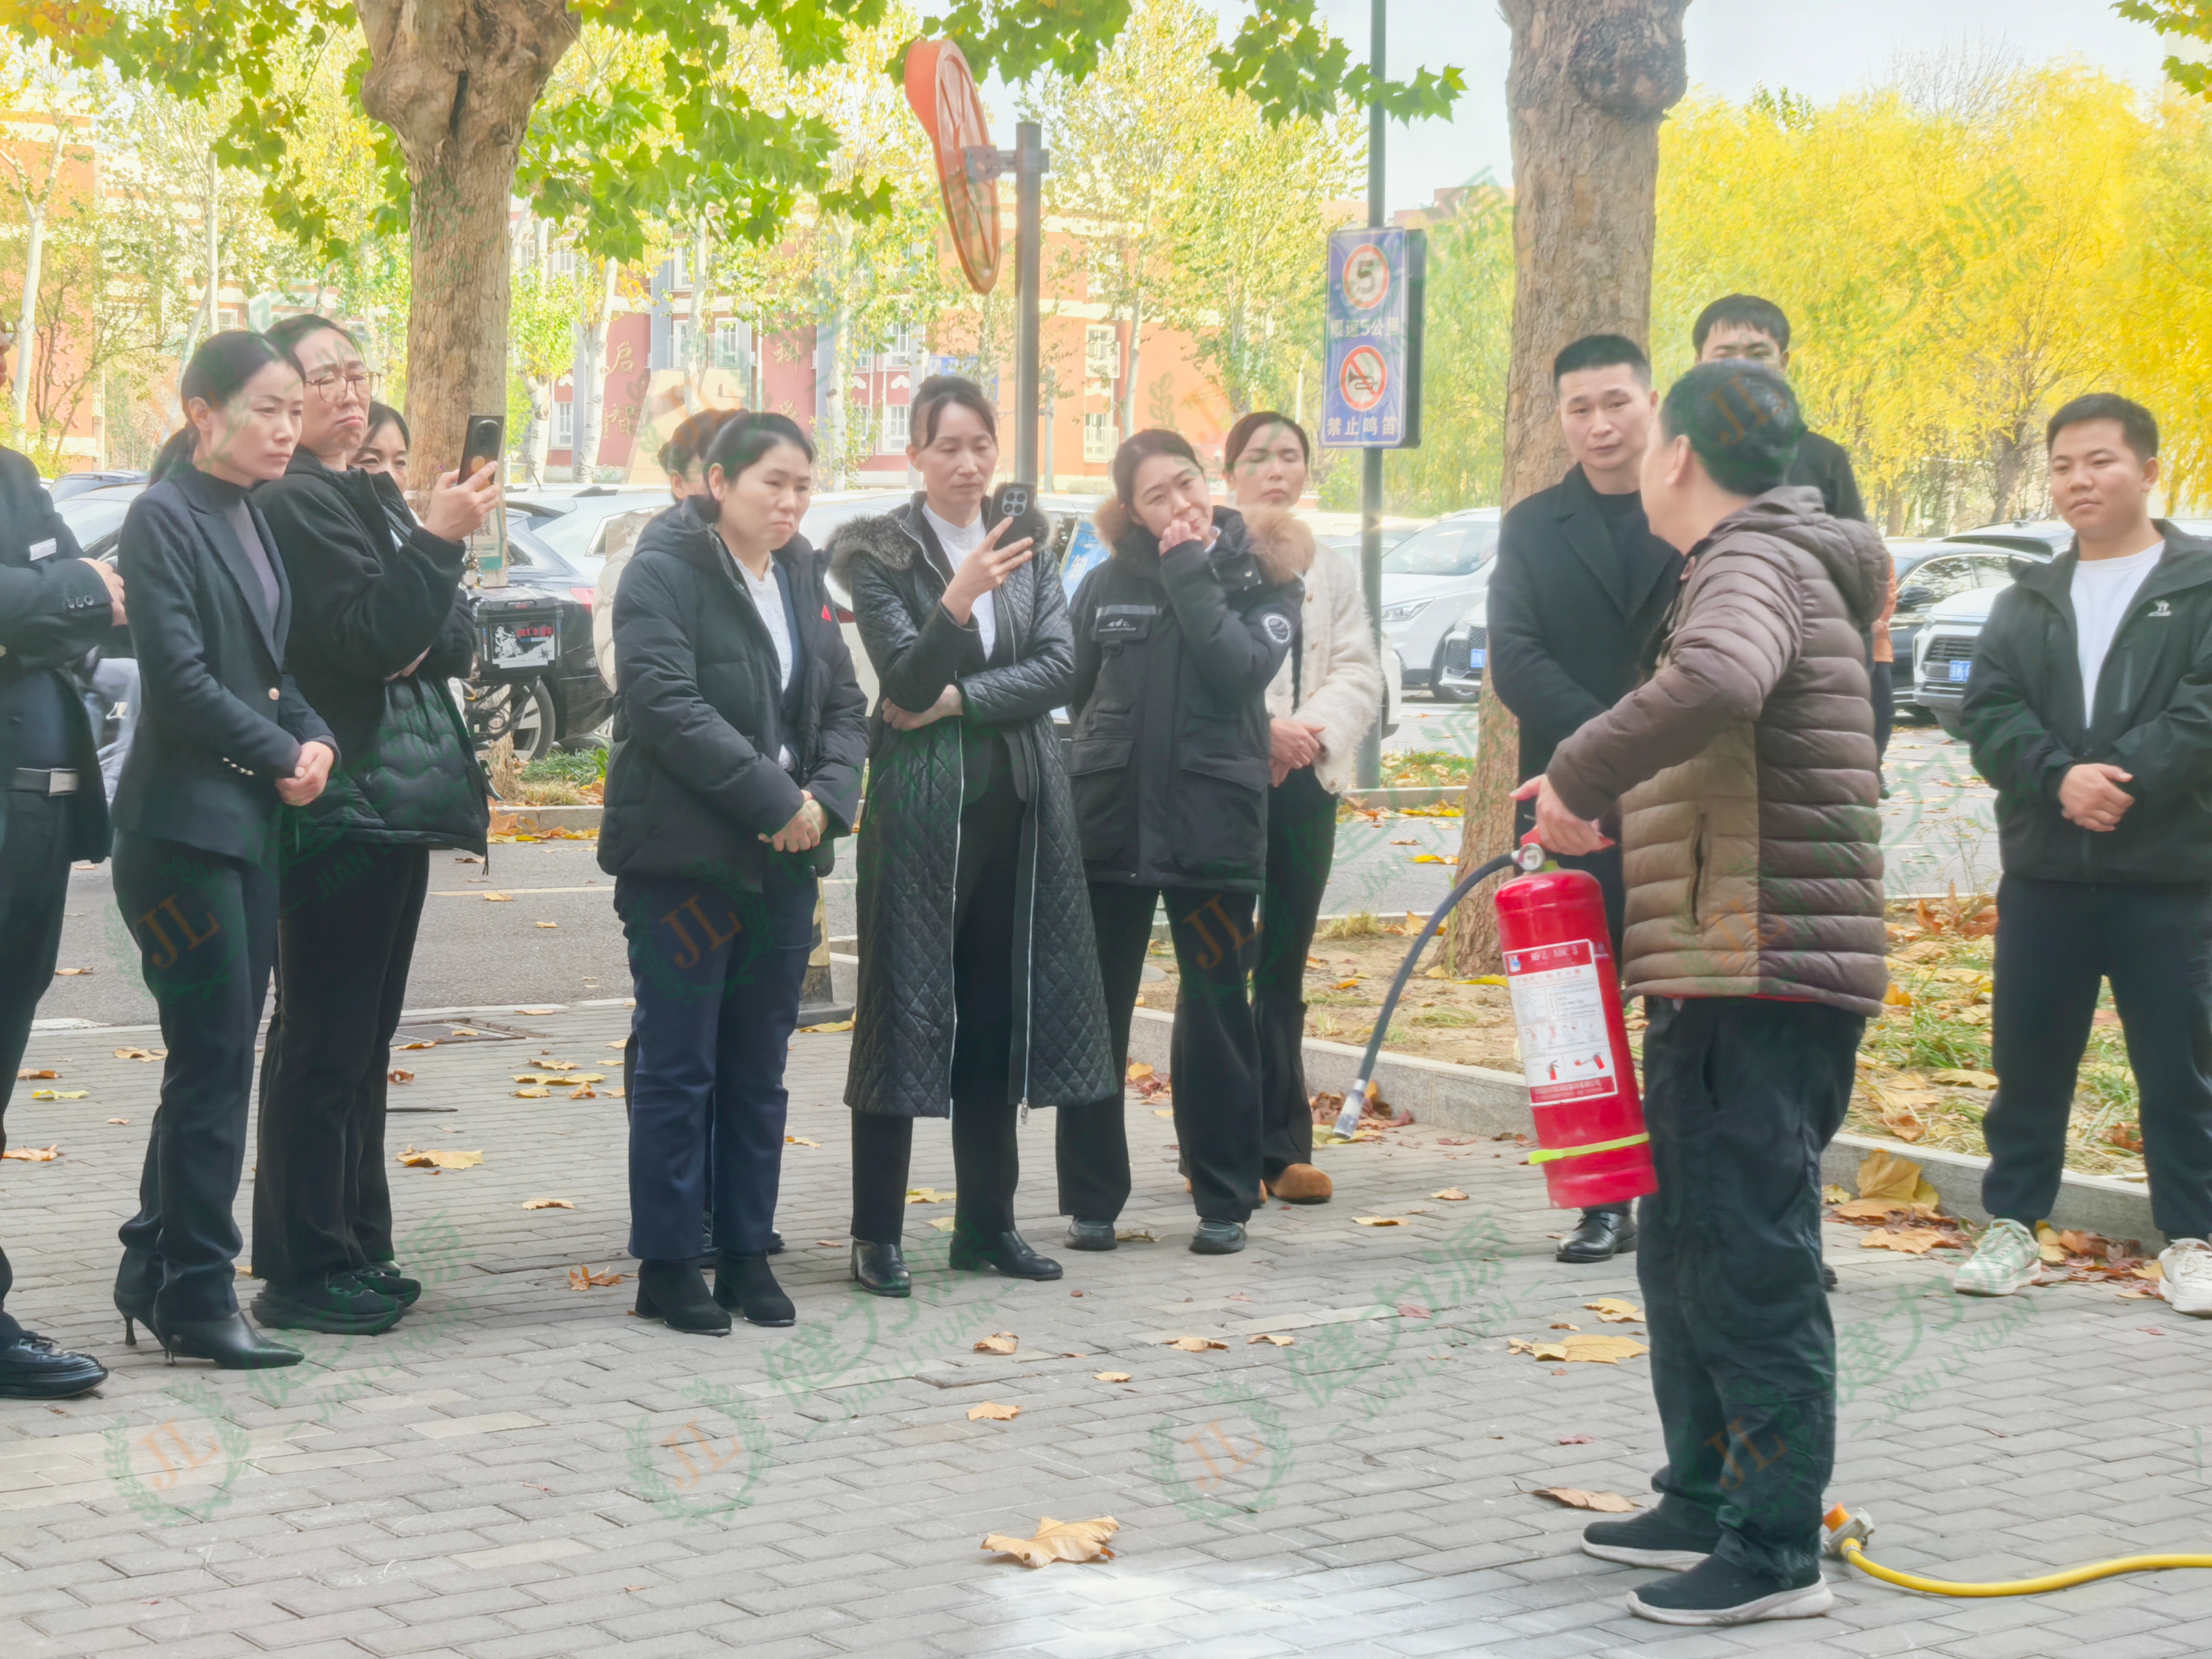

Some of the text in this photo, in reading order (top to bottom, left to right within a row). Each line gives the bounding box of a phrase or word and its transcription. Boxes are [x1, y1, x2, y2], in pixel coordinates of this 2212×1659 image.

[1357, 260, 1375, 294] 5
[1330, 317, 1401, 338] 限速5公里
[1326, 417, 1398, 436] 禁止鸣笛
